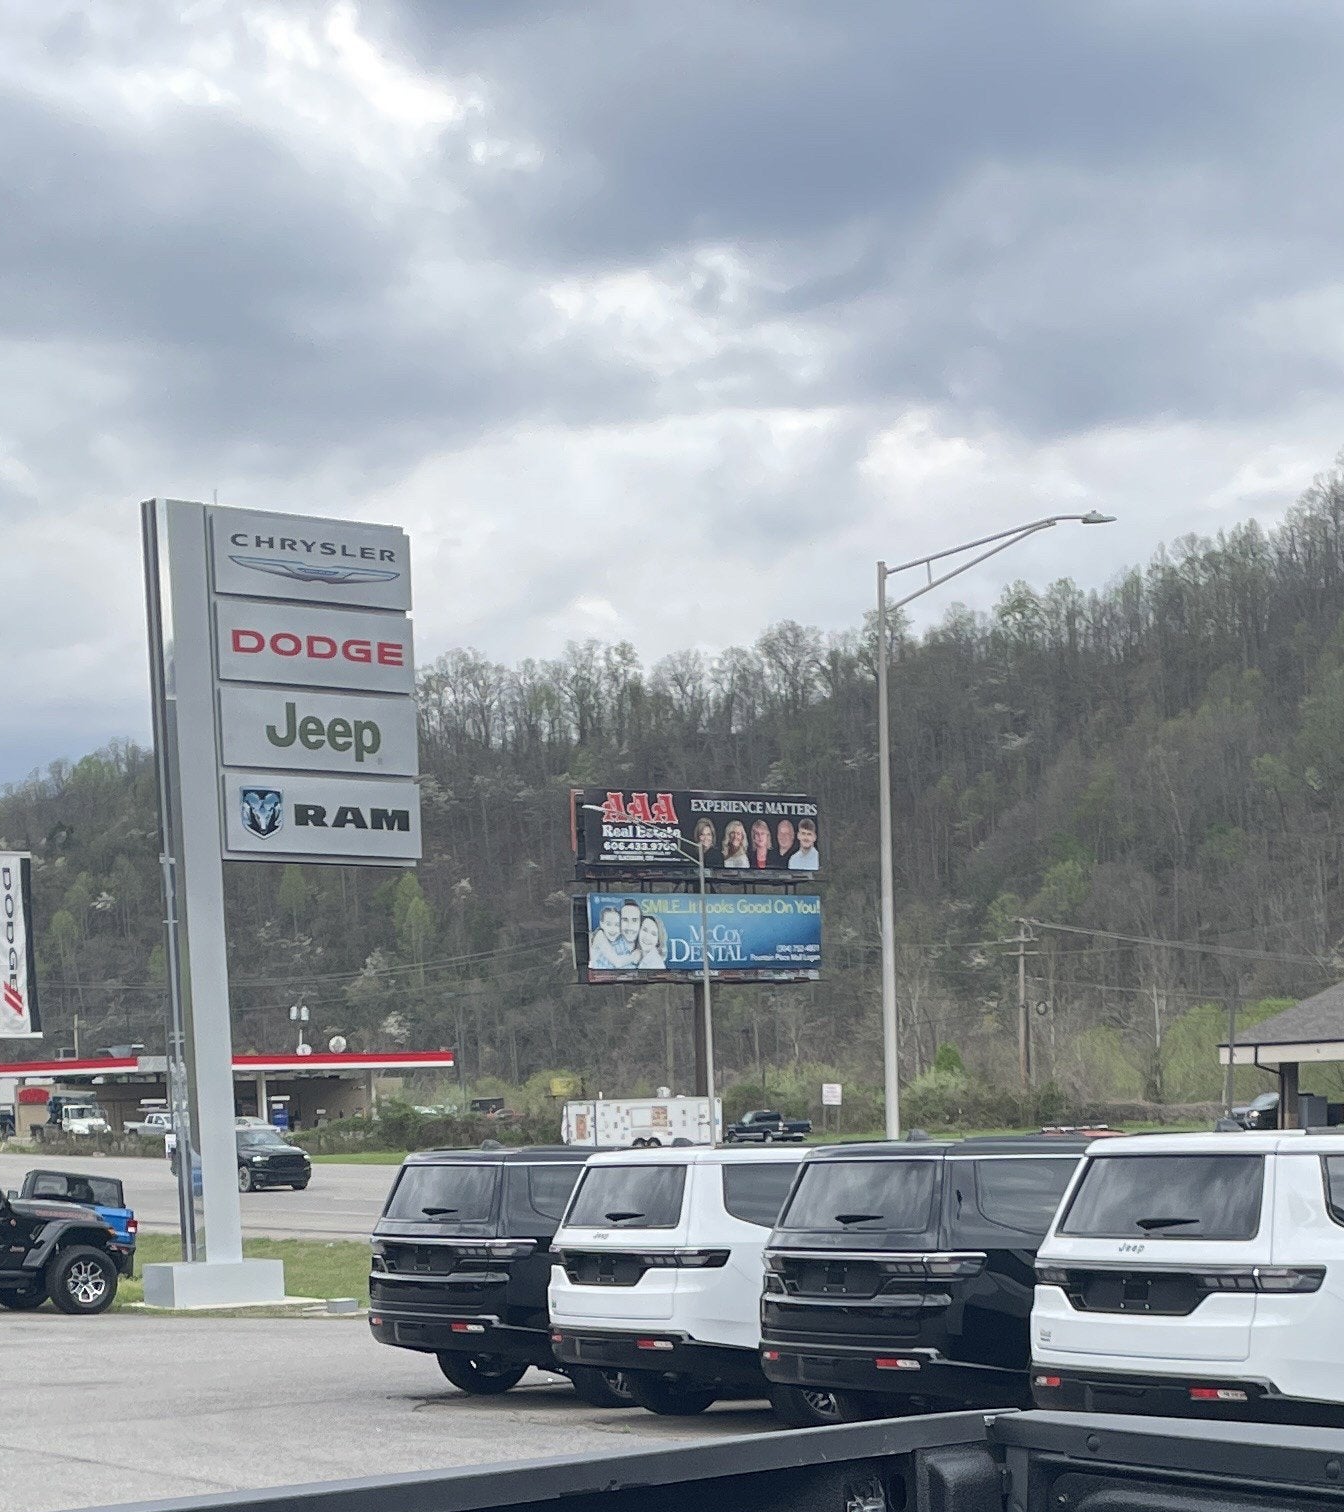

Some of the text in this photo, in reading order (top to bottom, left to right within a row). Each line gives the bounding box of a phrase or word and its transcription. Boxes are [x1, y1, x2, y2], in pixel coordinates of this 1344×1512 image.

[230, 532, 396, 564] CHRYSLER
[231, 629, 404, 667] DODGE
[266, 702, 381, 762] Jeep
[294, 803, 411, 832] RAM
[601, 791, 679, 824] AAA
[690, 799, 818, 816] EXPERIENCE MATTERS
[602, 825, 633, 837] Real
[737, 899, 772, 914] Good
[774, 899, 794, 913] On
[795, 899, 821, 914] You!
[2, 867, 19, 996] DODGE
